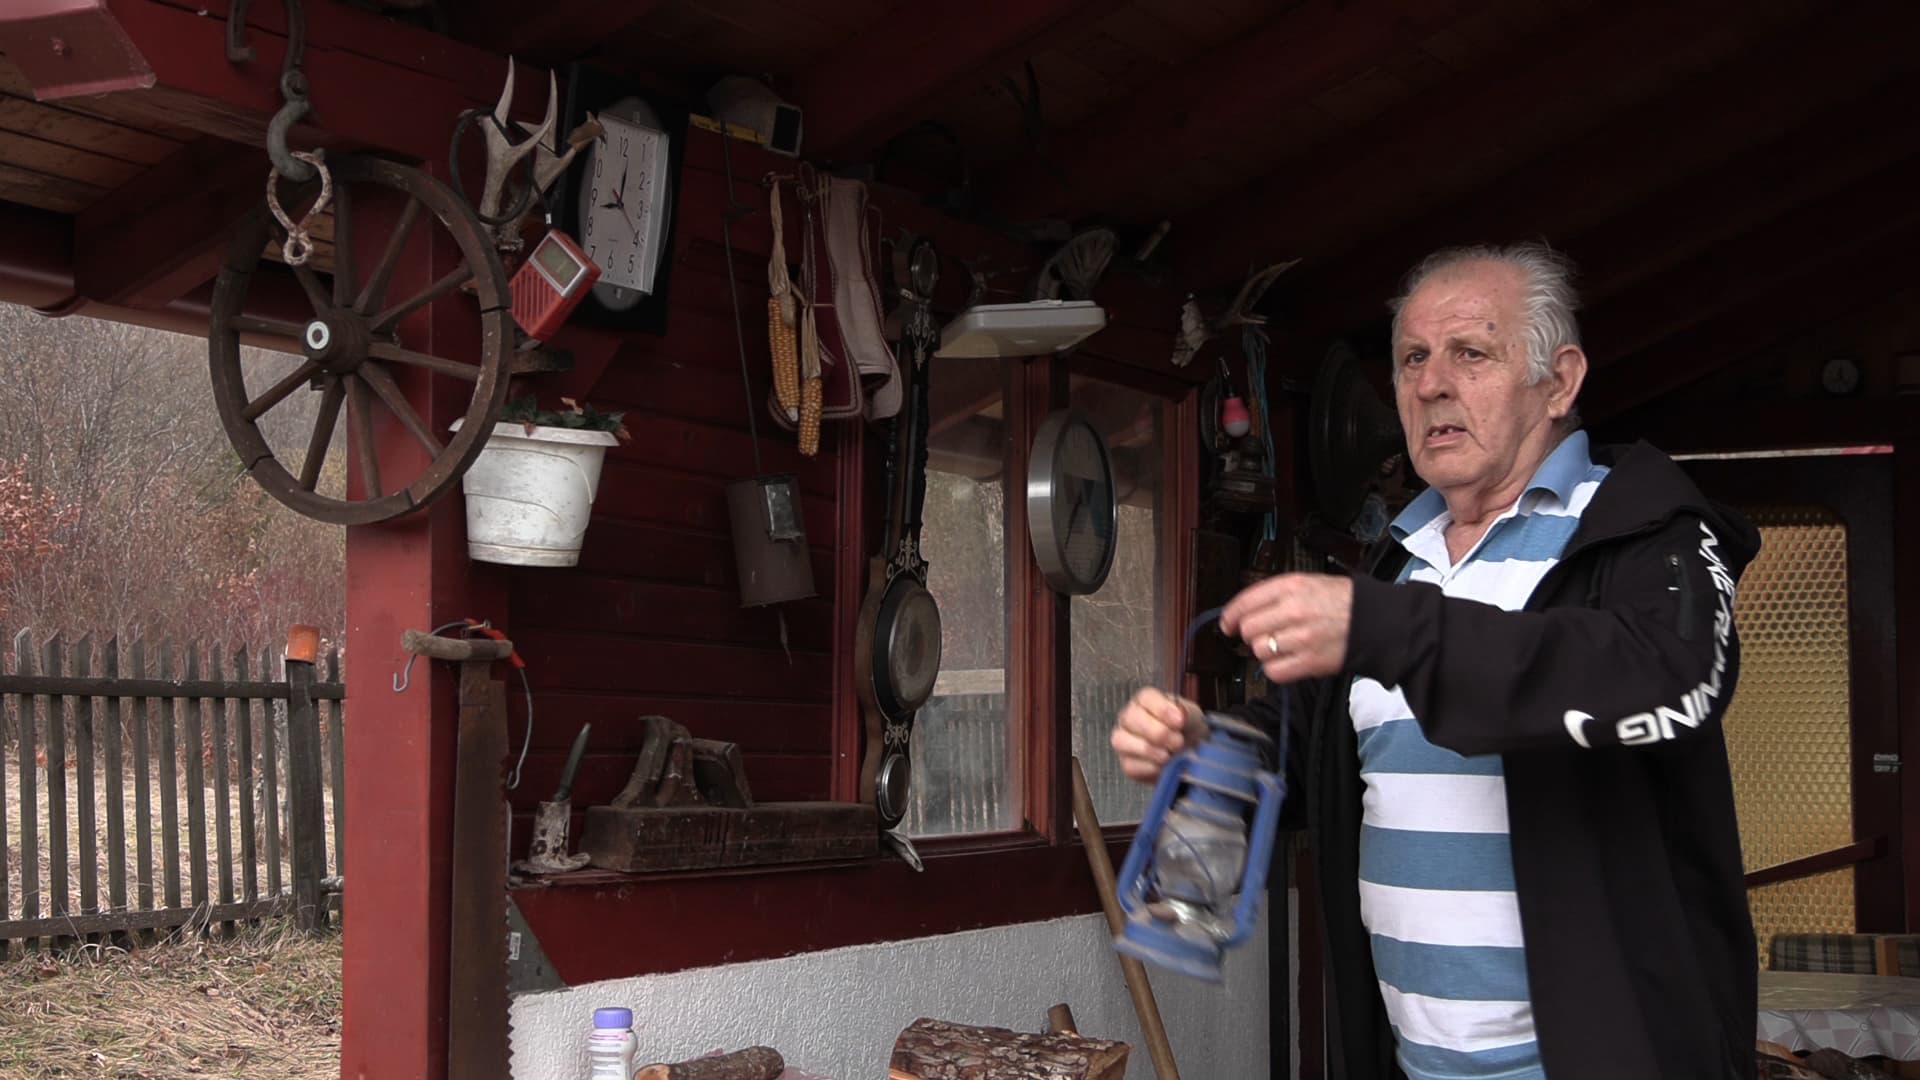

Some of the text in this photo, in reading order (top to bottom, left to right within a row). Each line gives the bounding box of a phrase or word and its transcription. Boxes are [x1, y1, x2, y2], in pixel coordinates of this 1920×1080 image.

[619, 136, 629, 157] 12
[639, 171, 645, 190] 2
[592, 188, 598, 207] 9
[637, 200, 643, 219] 3
[587, 216, 593, 236] 8
[633, 230, 640, 248] 4
[608, 249, 613, 269] 6
[628, 254, 635, 273] 5
